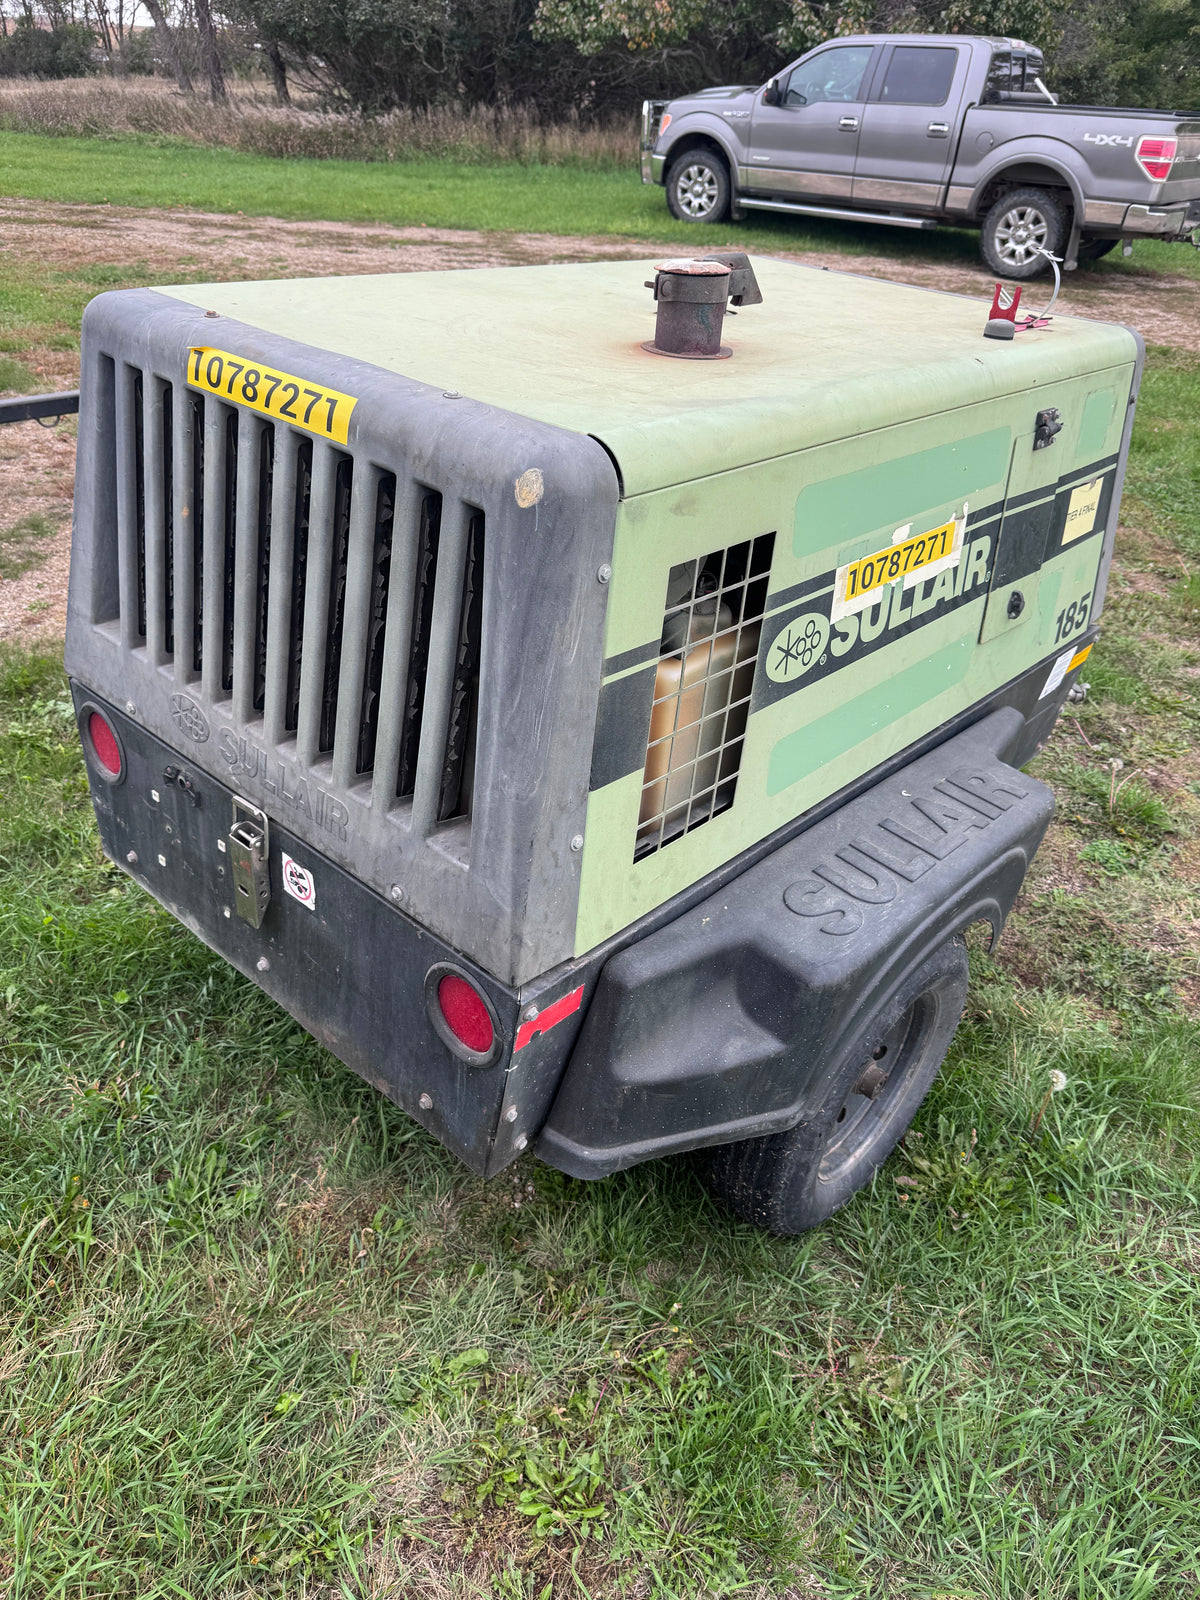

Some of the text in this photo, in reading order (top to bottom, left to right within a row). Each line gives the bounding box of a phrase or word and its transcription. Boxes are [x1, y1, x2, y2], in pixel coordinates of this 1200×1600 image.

[193, 350, 338, 433] 10787271
[830, 535, 991, 657] SULLAIR
[849, 530, 948, 596] 10787271
[1054, 591, 1092, 645] 185
[219, 726, 350, 843] SULLAIR
[783, 768, 1029, 936] SULLAIR
